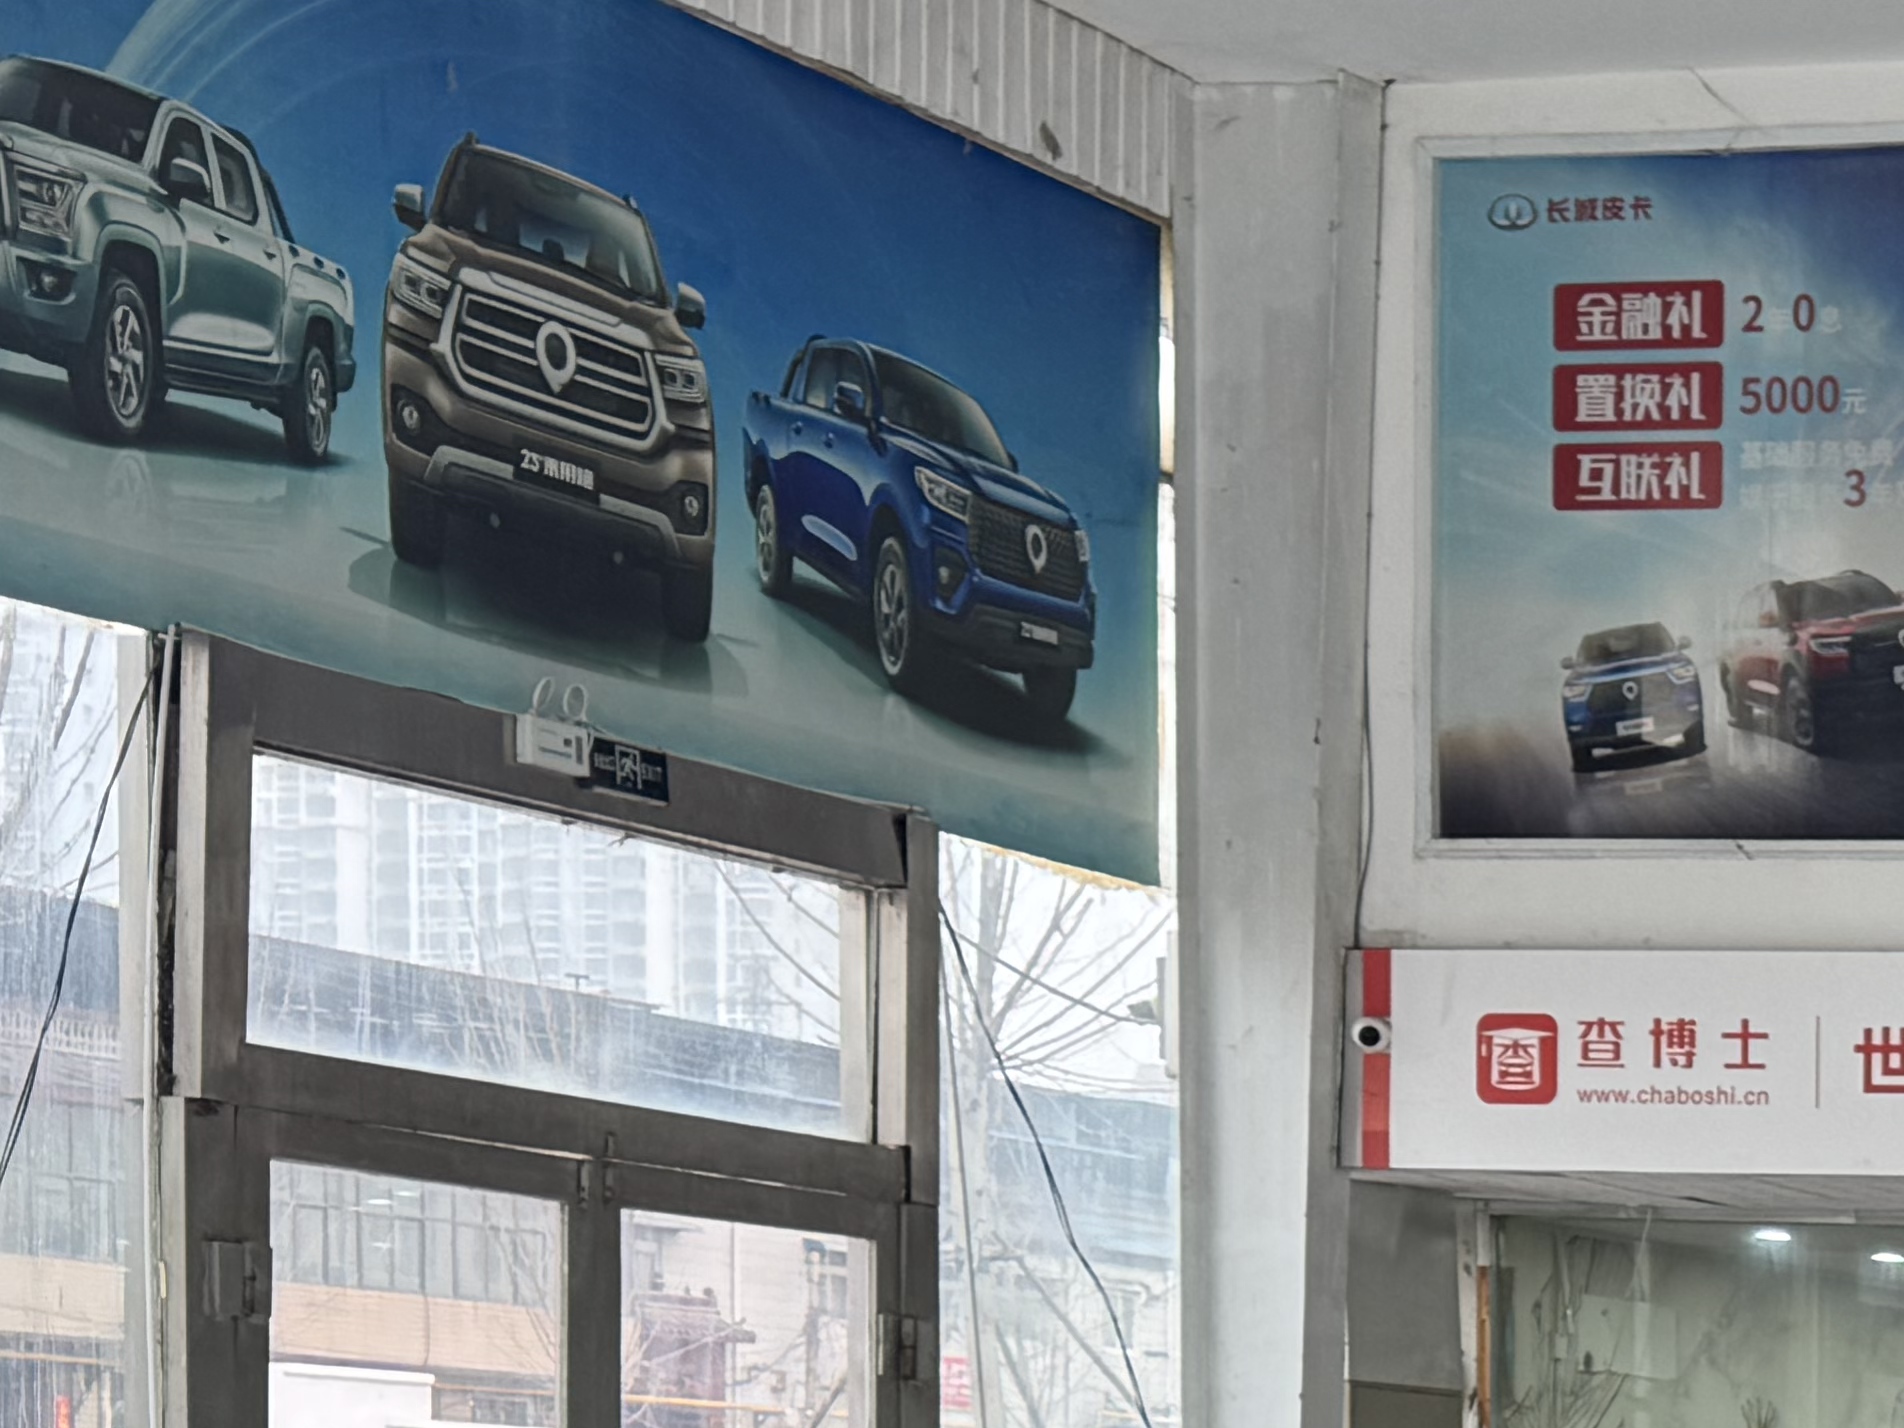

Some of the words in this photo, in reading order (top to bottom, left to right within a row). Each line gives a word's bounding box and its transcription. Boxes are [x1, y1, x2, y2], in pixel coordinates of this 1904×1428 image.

[1546, 196, 1653, 224] 长城皮卡
[1574, 289, 1708, 342] 金融礼
[1574, 371, 1706, 423] 置换礼
[1574, 451, 1706, 501] 互联礼
[1577, 1018, 1769, 1069] 查博士
[1577, 1087, 1769, 1105] www.chaboshi.cn
